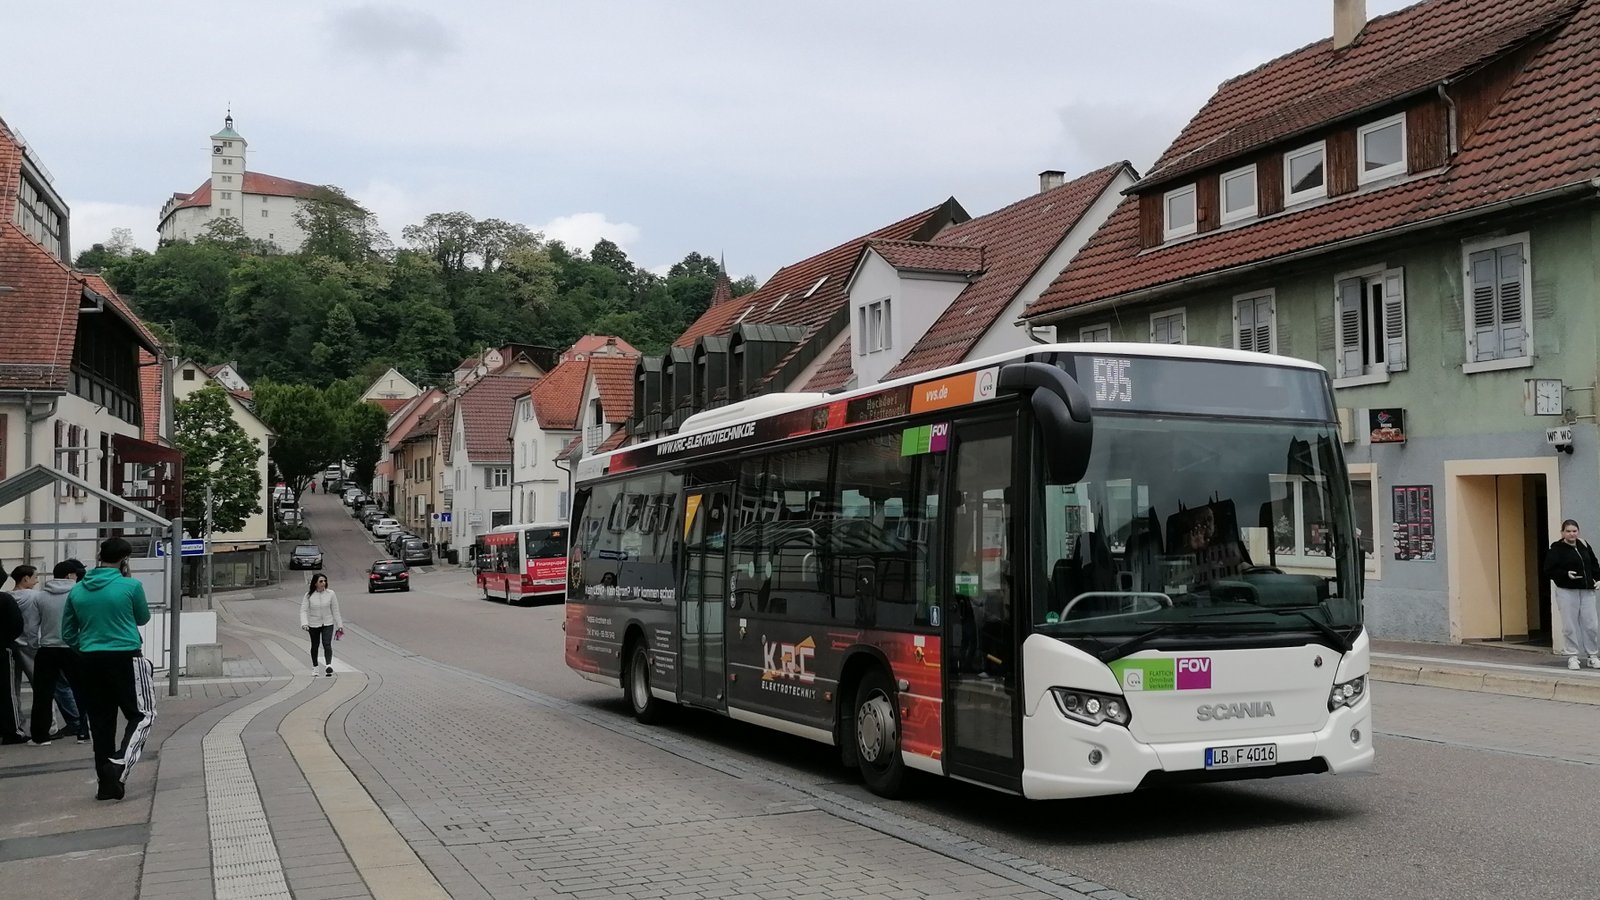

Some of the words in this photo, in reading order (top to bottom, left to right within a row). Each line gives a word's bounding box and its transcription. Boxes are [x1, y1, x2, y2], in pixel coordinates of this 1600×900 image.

[1093, 358, 1132, 402] 595
[926, 384, 949, 402] vvs.de
[656, 421, 757, 456] WWW.KRC-ELEKTROTECHNIK.DE
[932, 423, 949, 438] FOV
[1178, 659, 1210, 673] FOV
[761, 680, 817, 700] ELEKTROTECHNIK
[1197, 701, 1275, 721] SCANIA
[1213, 749, 1229, 764] LB
[1236, 748, 1245, 763] F
[1246, 746, 1275, 762] 4016
